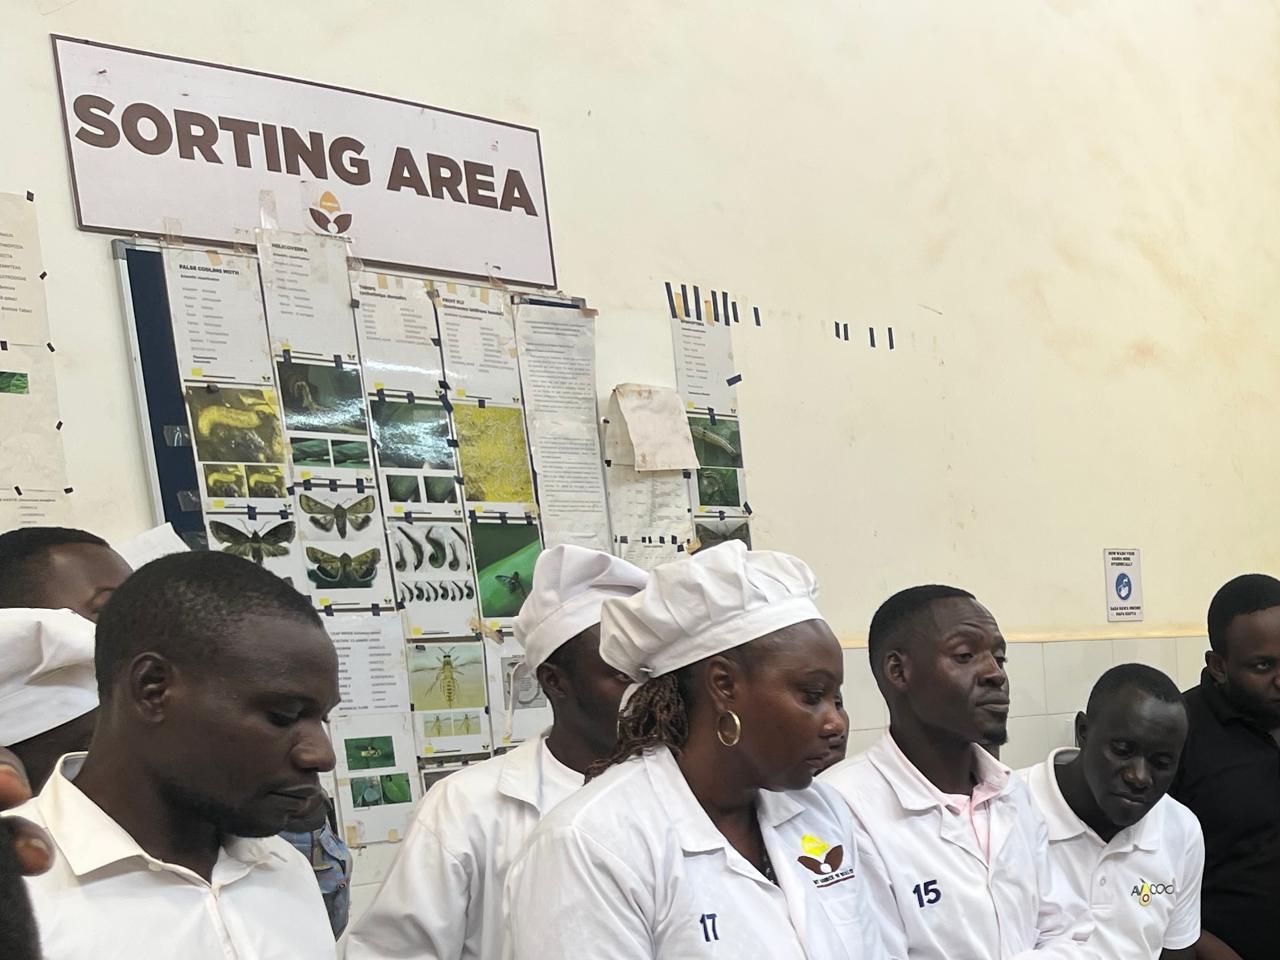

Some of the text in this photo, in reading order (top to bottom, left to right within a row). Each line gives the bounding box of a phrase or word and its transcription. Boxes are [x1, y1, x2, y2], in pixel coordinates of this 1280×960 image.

[73, 94, 539, 217] SORTING AREA
[912, 879, 942, 908] 15
[699, 913, 720, 942] 17
